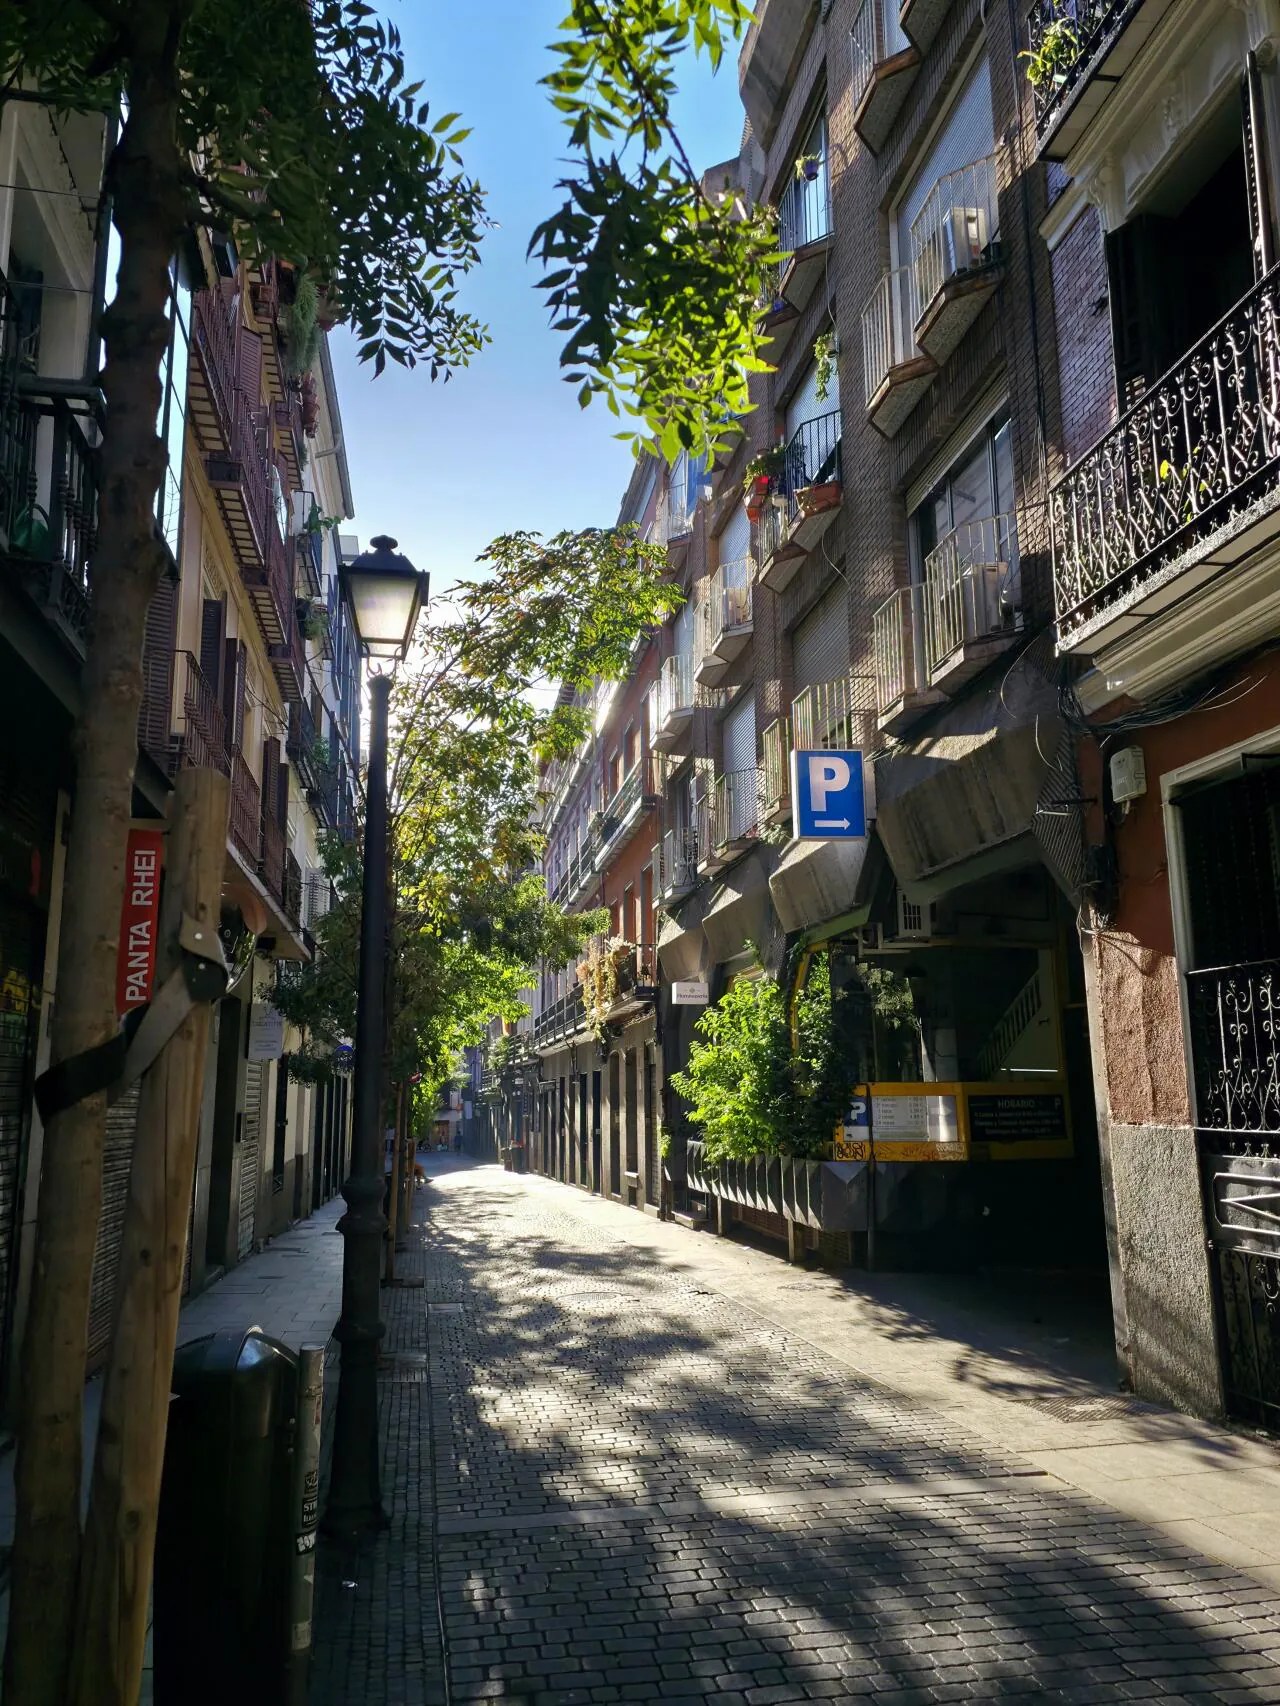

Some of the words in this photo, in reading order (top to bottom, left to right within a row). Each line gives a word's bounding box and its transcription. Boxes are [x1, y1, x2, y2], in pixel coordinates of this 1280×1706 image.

[808, 756, 851, 812] P
[131, 850, 156, 906] RHEI
[125, 920, 151, 1001] PANTA
[997, 1098, 1036, 1109] HORARIO
